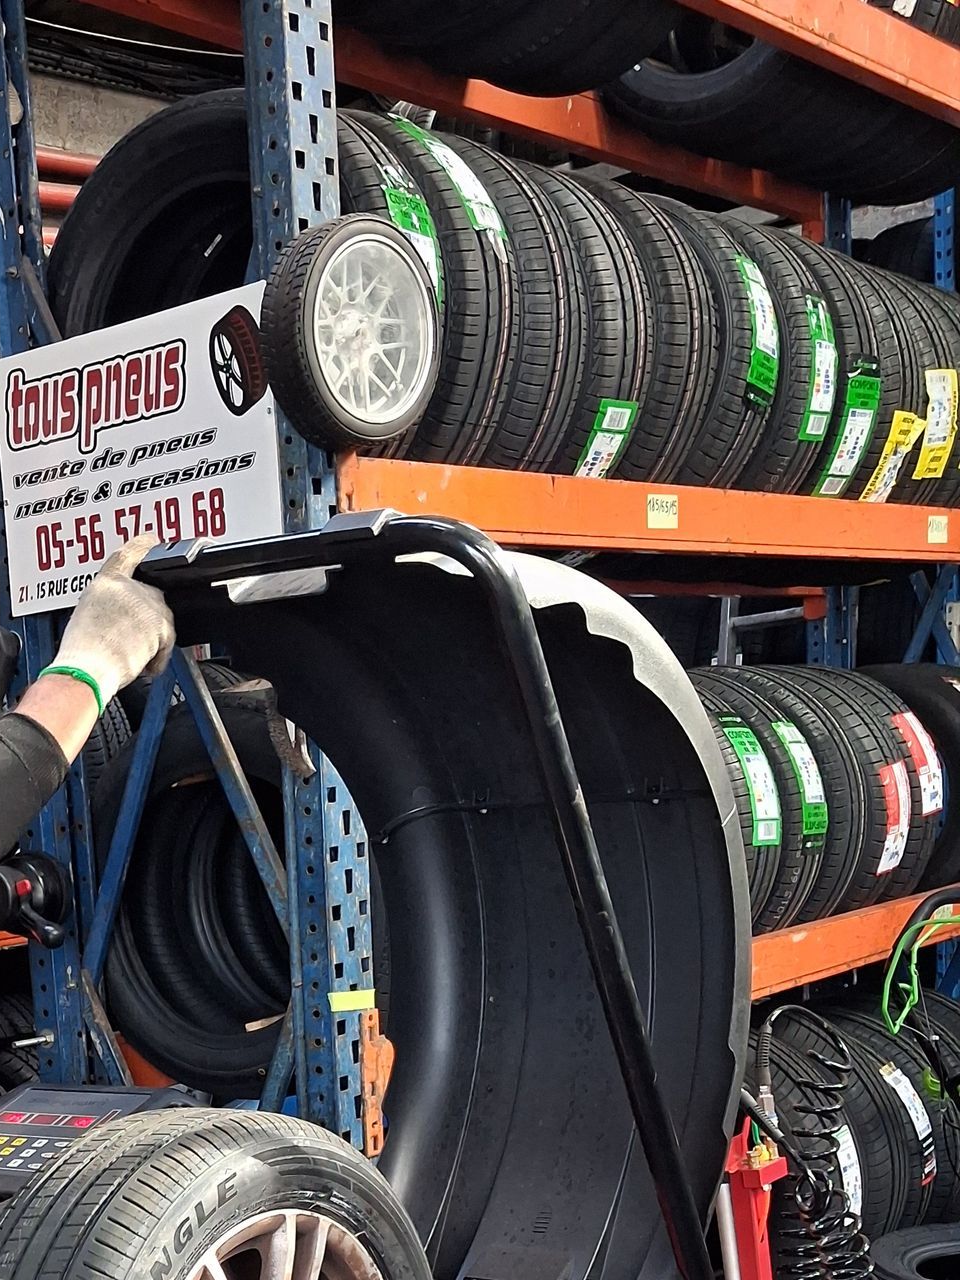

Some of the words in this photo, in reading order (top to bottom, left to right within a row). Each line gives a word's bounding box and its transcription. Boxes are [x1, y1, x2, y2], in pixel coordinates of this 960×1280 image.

[14, 459, 86, 488] vente
[90, 447, 126, 470] de
[128, 428, 217, 467] pneus
[14, 487, 88, 519] neufs
[92, 481, 111, 502] &
[117, 452, 256, 496] occasions
[36, 513, 104, 571] 05-56
[115, 498, 181, 546] 57-19
[192, 488, 226, 537] 68
[36, 581, 46, 599] 15
[48, 578, 69, 597] RUE
